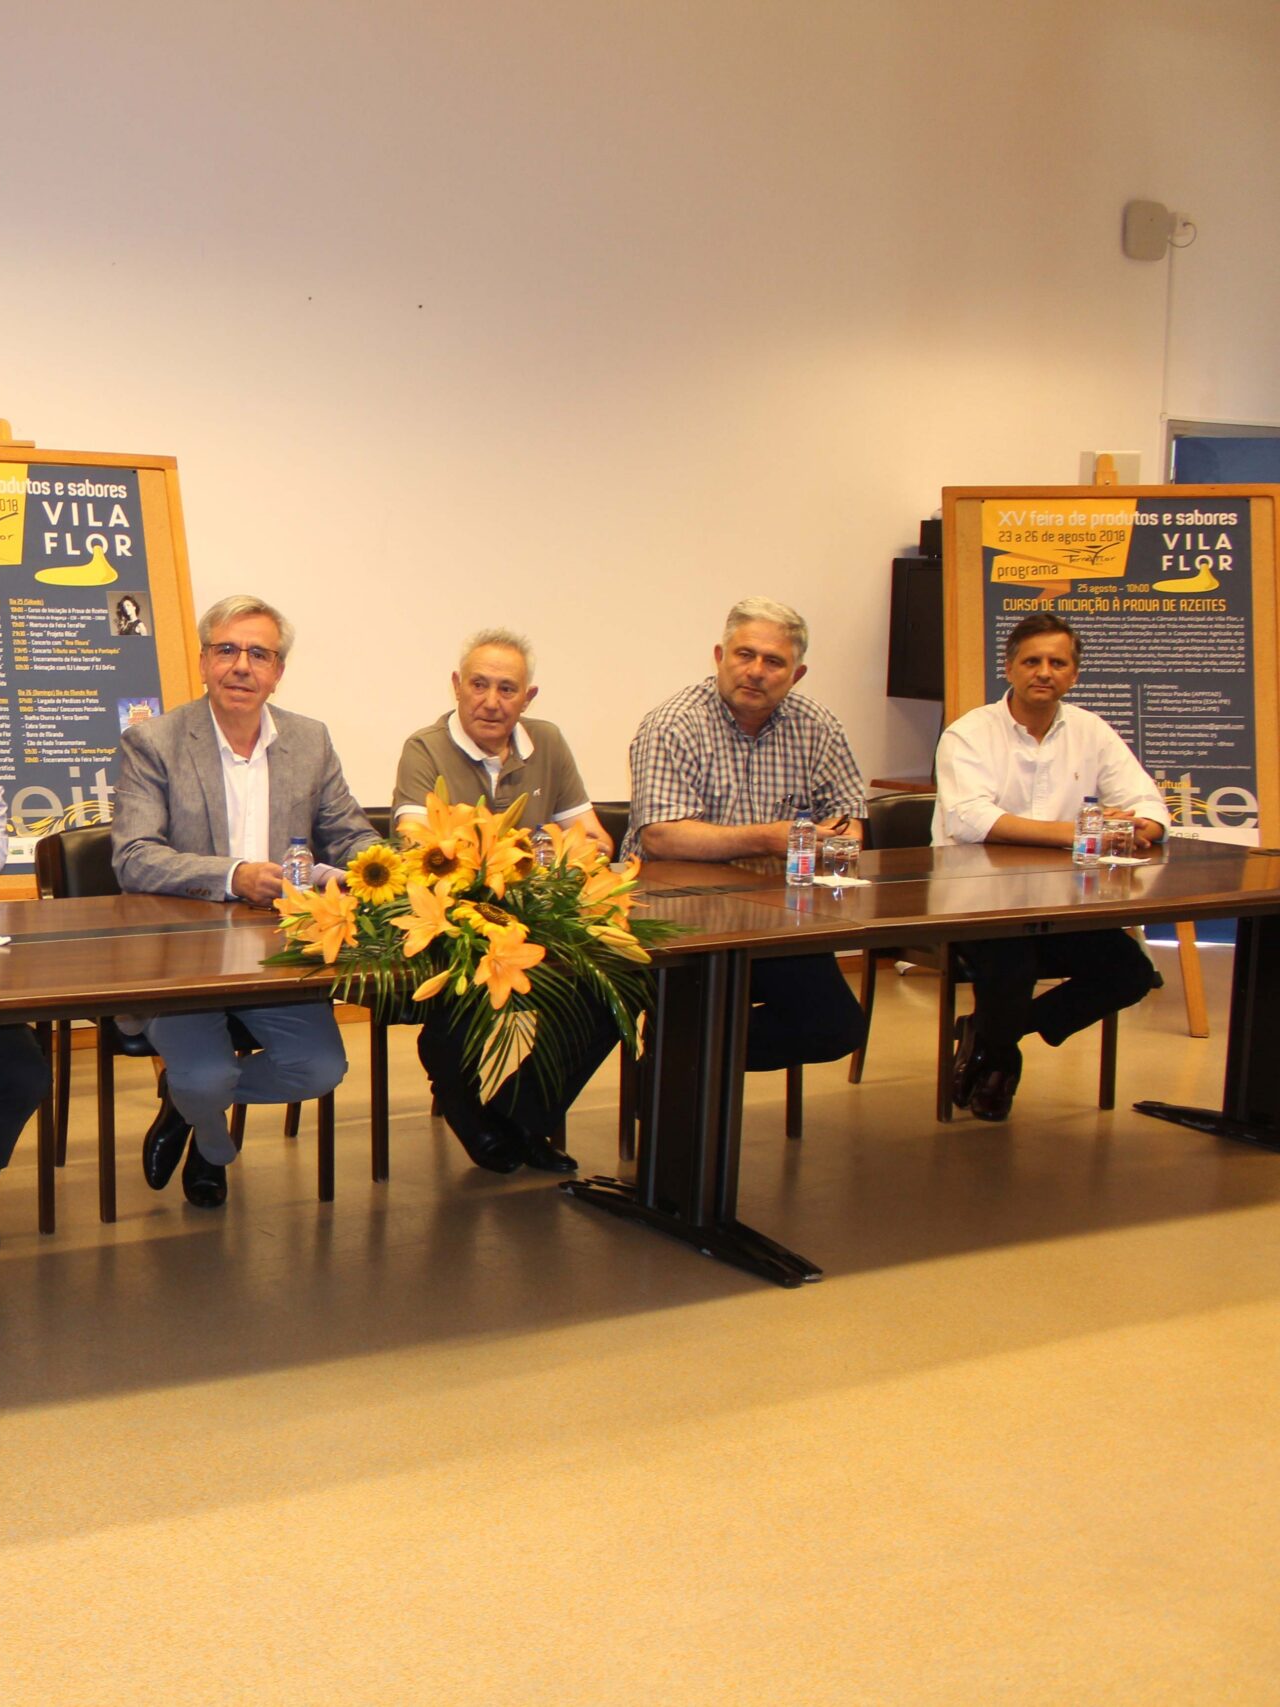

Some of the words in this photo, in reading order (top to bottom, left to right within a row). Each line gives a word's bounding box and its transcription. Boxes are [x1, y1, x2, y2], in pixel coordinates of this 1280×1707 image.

[56, 482, 64, 495] e
[68, 479, 127, 499] sabores
[42, 502, 130, 528] VILA
[998, 512, 1027, 526] XV
[1030, 511, 1064, 526] feira
[1069, 511, 1085, 526] de
[1091, 511, 1158, 528] produtos
[1163, 515, 1171, 525] e
[1176, 510, 1238, 526] sabores
[44, 532, 133, 557] FLOR
[999, 531, 1012, 542] 23
[1015, 533, 1021, 542] a
[1025, 531, 1038, 542] 26
[1042, 531, 1054, 542] de
[1058, 530, 1096, 544] agosto
[1100, 530, 1125, 542] 2018
[1163, 533, 1233, 550] VILA
[1162, 555, 1233, 571] FLOR
[998, 565, 1058, 579] programa
[1077, 584, 1088, 593] 25
[1089, 585, 1117, 595] agosto
[1127, 584, 1149, 593] 10h00
[1003, 599, 1037, 611] CURSO
[1040, 599, 1054, 611] DE
[1059, 598, 1109, 615] INICIAÇÃO
[1113, 596, 1120, 611] À
[1162, 599, 1176, 611] DE
[1179, 599, 1226, 611] AZEITES
